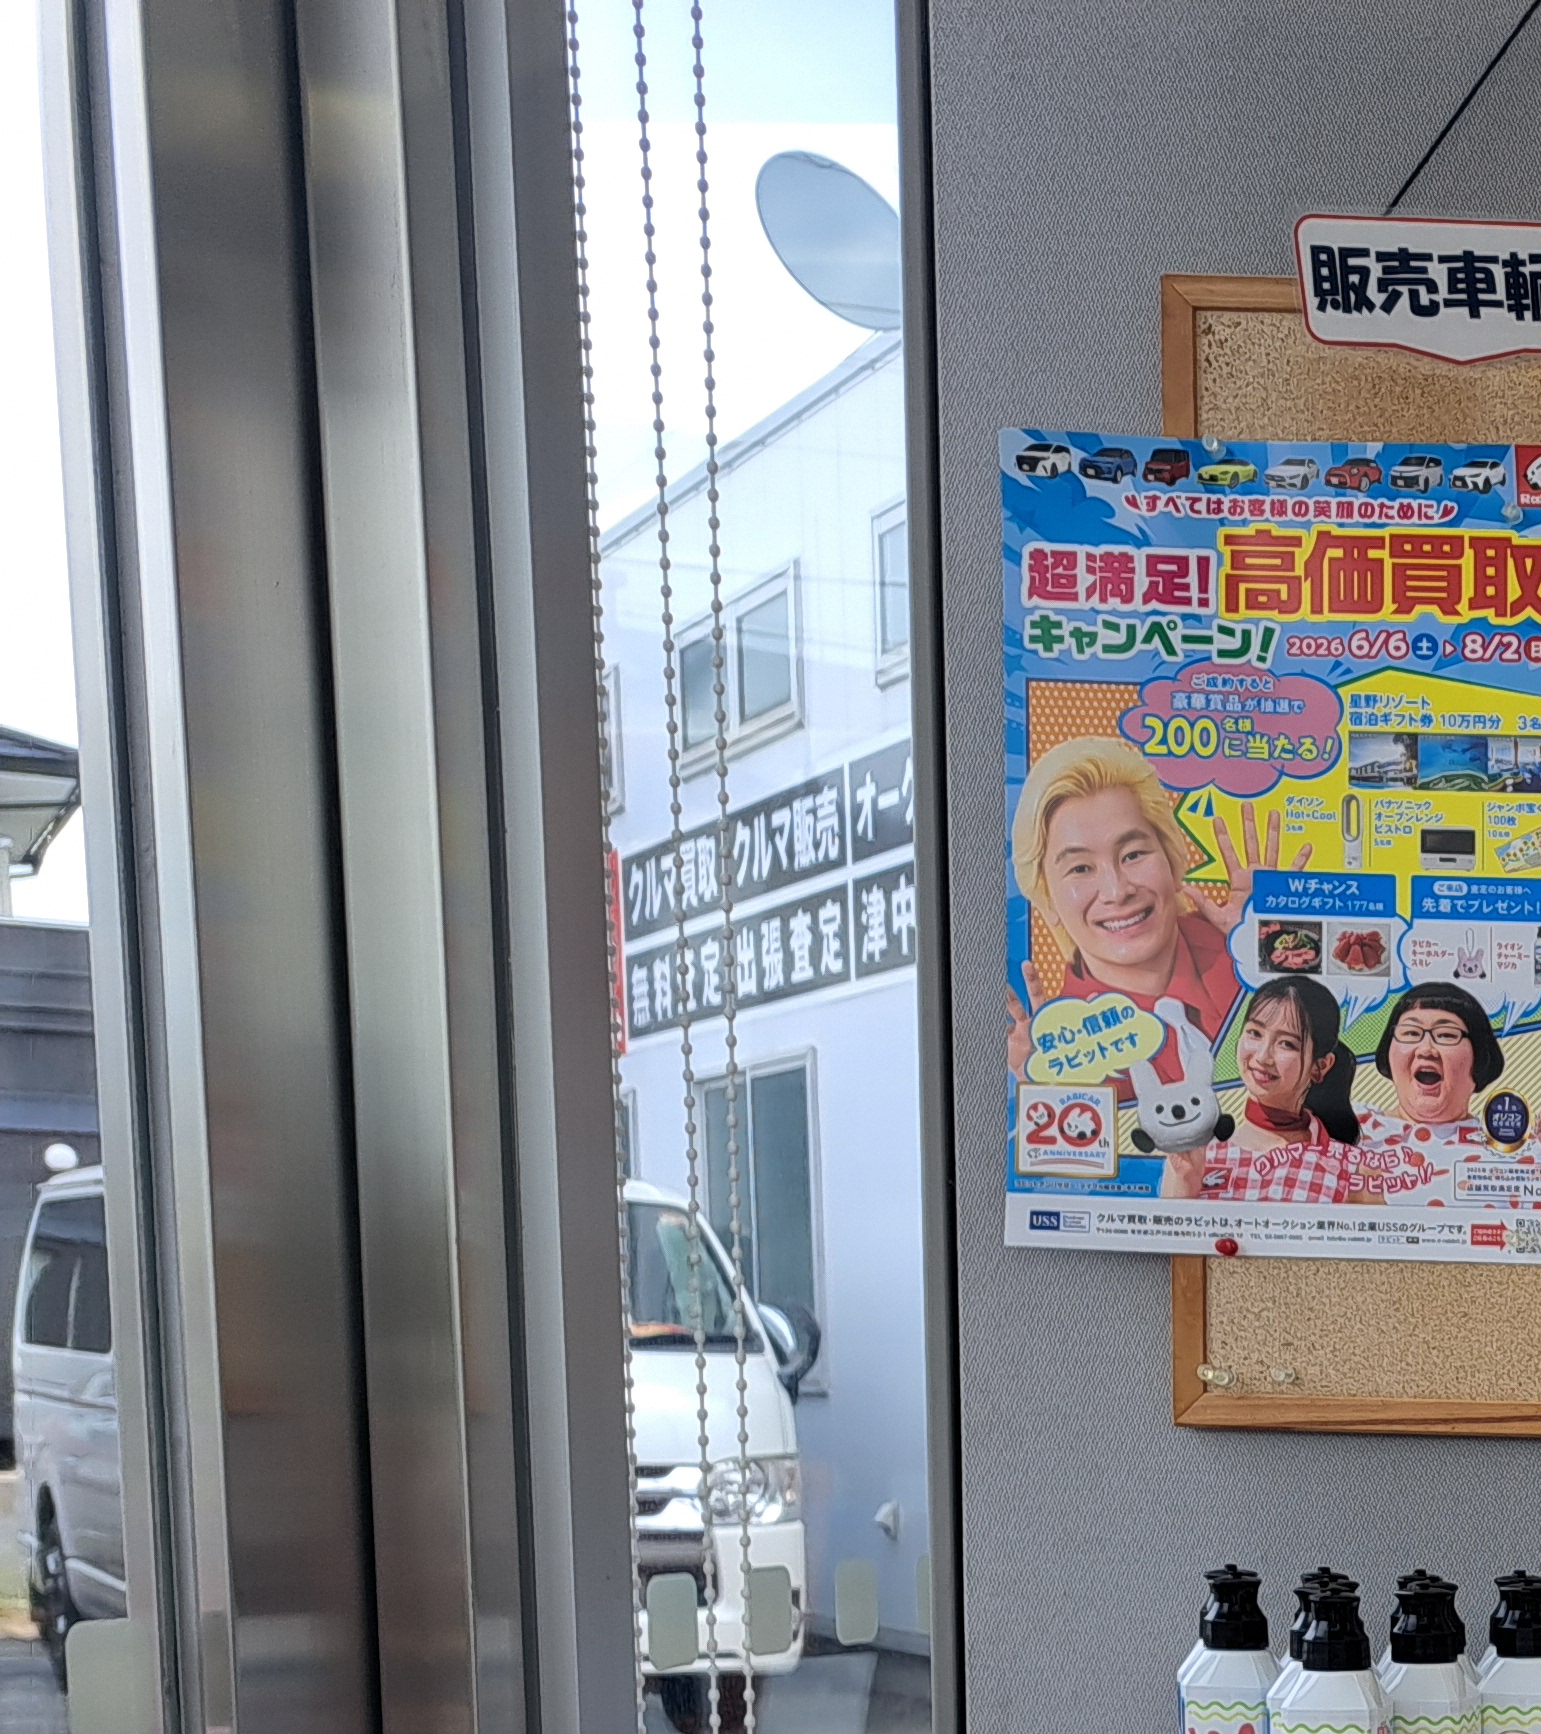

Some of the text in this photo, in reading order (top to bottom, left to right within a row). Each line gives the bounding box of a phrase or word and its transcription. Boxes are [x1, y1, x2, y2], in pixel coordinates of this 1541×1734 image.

[1287, 637, 1343, 656] 2026
[1192, 675, 1273, 691] ご成約すると
[1349, 695, 1431, 709] 星野リゾート
[1349, 712, 1433, 727] 宿泊ギフト券
[1439, 714, 1502, 730] 10万円分
[1487, 814, 1518, 827] 100枚
[628, 785, 840, 927] クルマ買取 クルマ販売
[1288, 879, 1359, 896] Wチャンス
[1265, 896, 1343, 910] カタログギフト
[632, 899, 844, 1027] 無料査定 出張査定
[1047, 1030, 1140, 1075] ラビットです
[1033, 1215, 1058, 1226] USS
